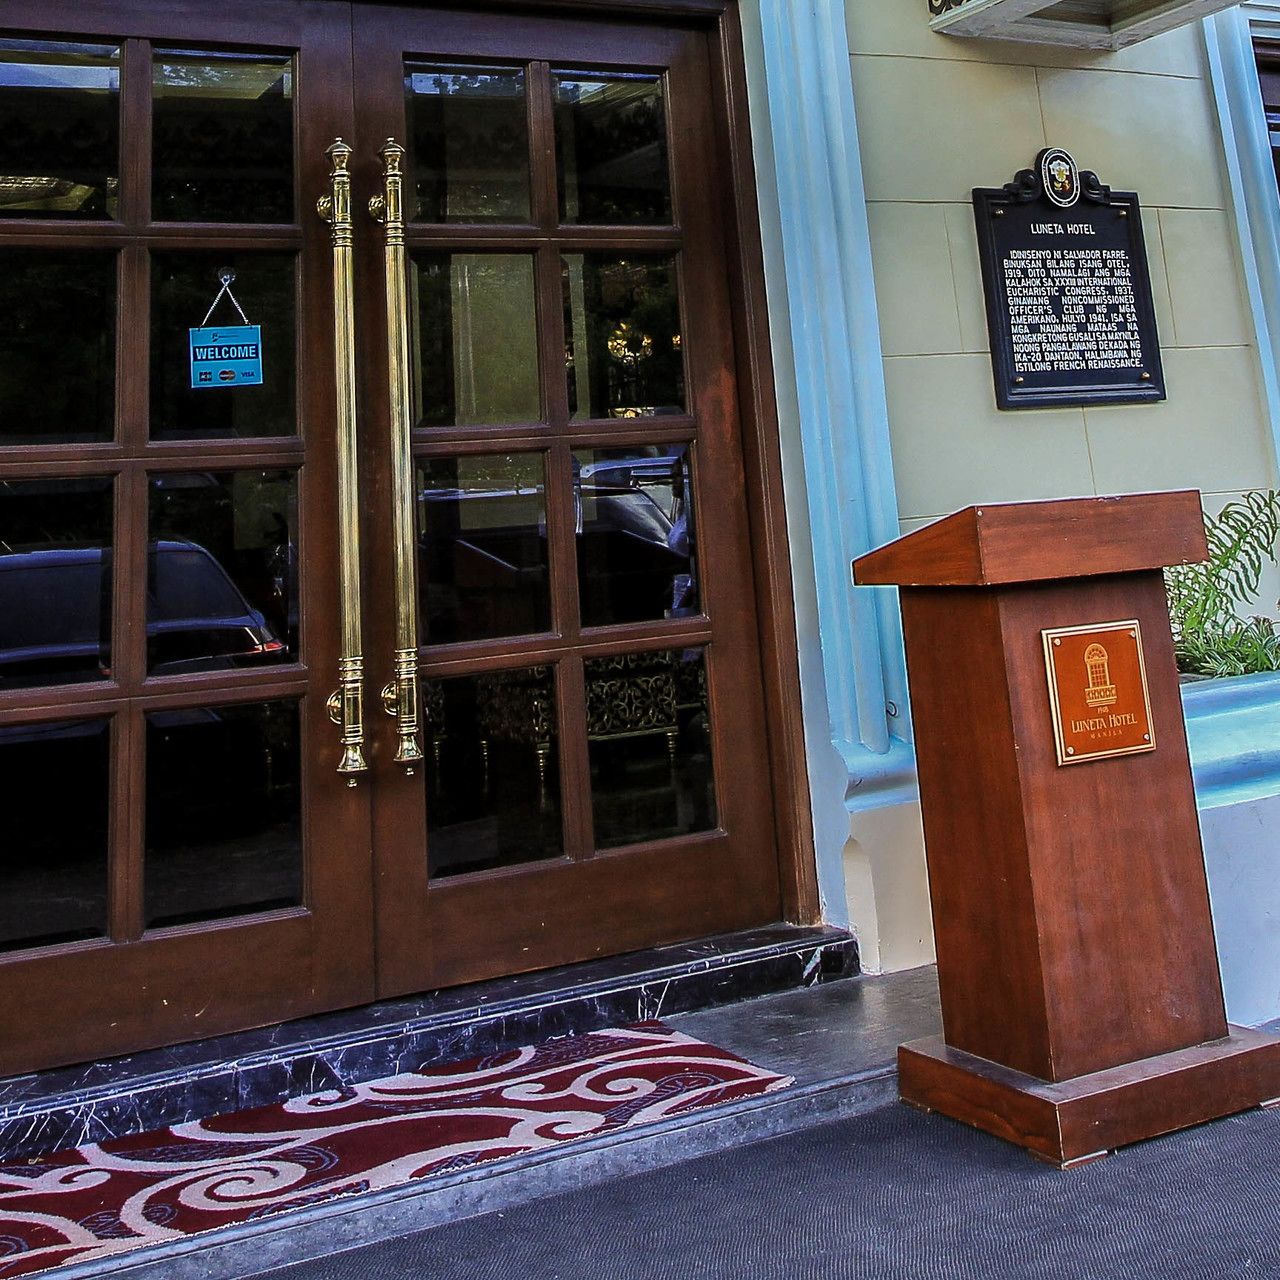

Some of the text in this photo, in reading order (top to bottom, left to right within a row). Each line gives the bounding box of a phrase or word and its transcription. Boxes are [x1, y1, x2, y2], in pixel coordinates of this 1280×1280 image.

[1031, 224, 1095, 234] LUNETA HOTEL
[1054, 251, 1061, 259] NI
[1064, 251, 1101, 259] SALVADOR
[1103, 251, 1128, 259] FARRE.
[1003, 259, 1042, 268] BINUKSAN
[1047, 260, 1075, 268] BILANG
[1079, 260, 1102, 268] ISANG
[1005, 269, 1023, 277] 1919.
[1028, 269, 1045, 277] DITO
[1051, 269, 1090, 277] NAMALAGI
[1006, 279, 1041, 287] KALAHOK
[1077, 278, 1132, 286] INTERNATIONAL
[1007, 288, 1059, 296] EUCHARISTIC
[1115, 287, 1133, 295] 1937.
[1008, 296, 1134, 305] GINAWANG NONCOMMISSIONED
[1009, 306, 1052, 314] OFFICER'S
[1096, 305, 1107, 313] NG
[1062, 315, 1085, 323] HULYO
[1111, 314, 1124, 322] ISA
[1011, 323, 1138, 333] MGA NAUNANG MATAAS NA
[1012, 332, 1139, 343] KONGKRETONG GUSALI SA MAYNILA
[1013, 341, 1140, 352] NOONG PANGALAWANG DEKADA NG
[195, 345, 256, 360] WELCOME
[1015, 353, 1041, 361] IKA-20
[1085, 350, 1128, 359] HALIMBAWA
[1131, 350, 1141, 358] NG
[1015, 359, 1143, 372] ISTILONG FRENCH RENAISSANCE.
[1071, 713, 1138, 733] LUNETA HOTEL
